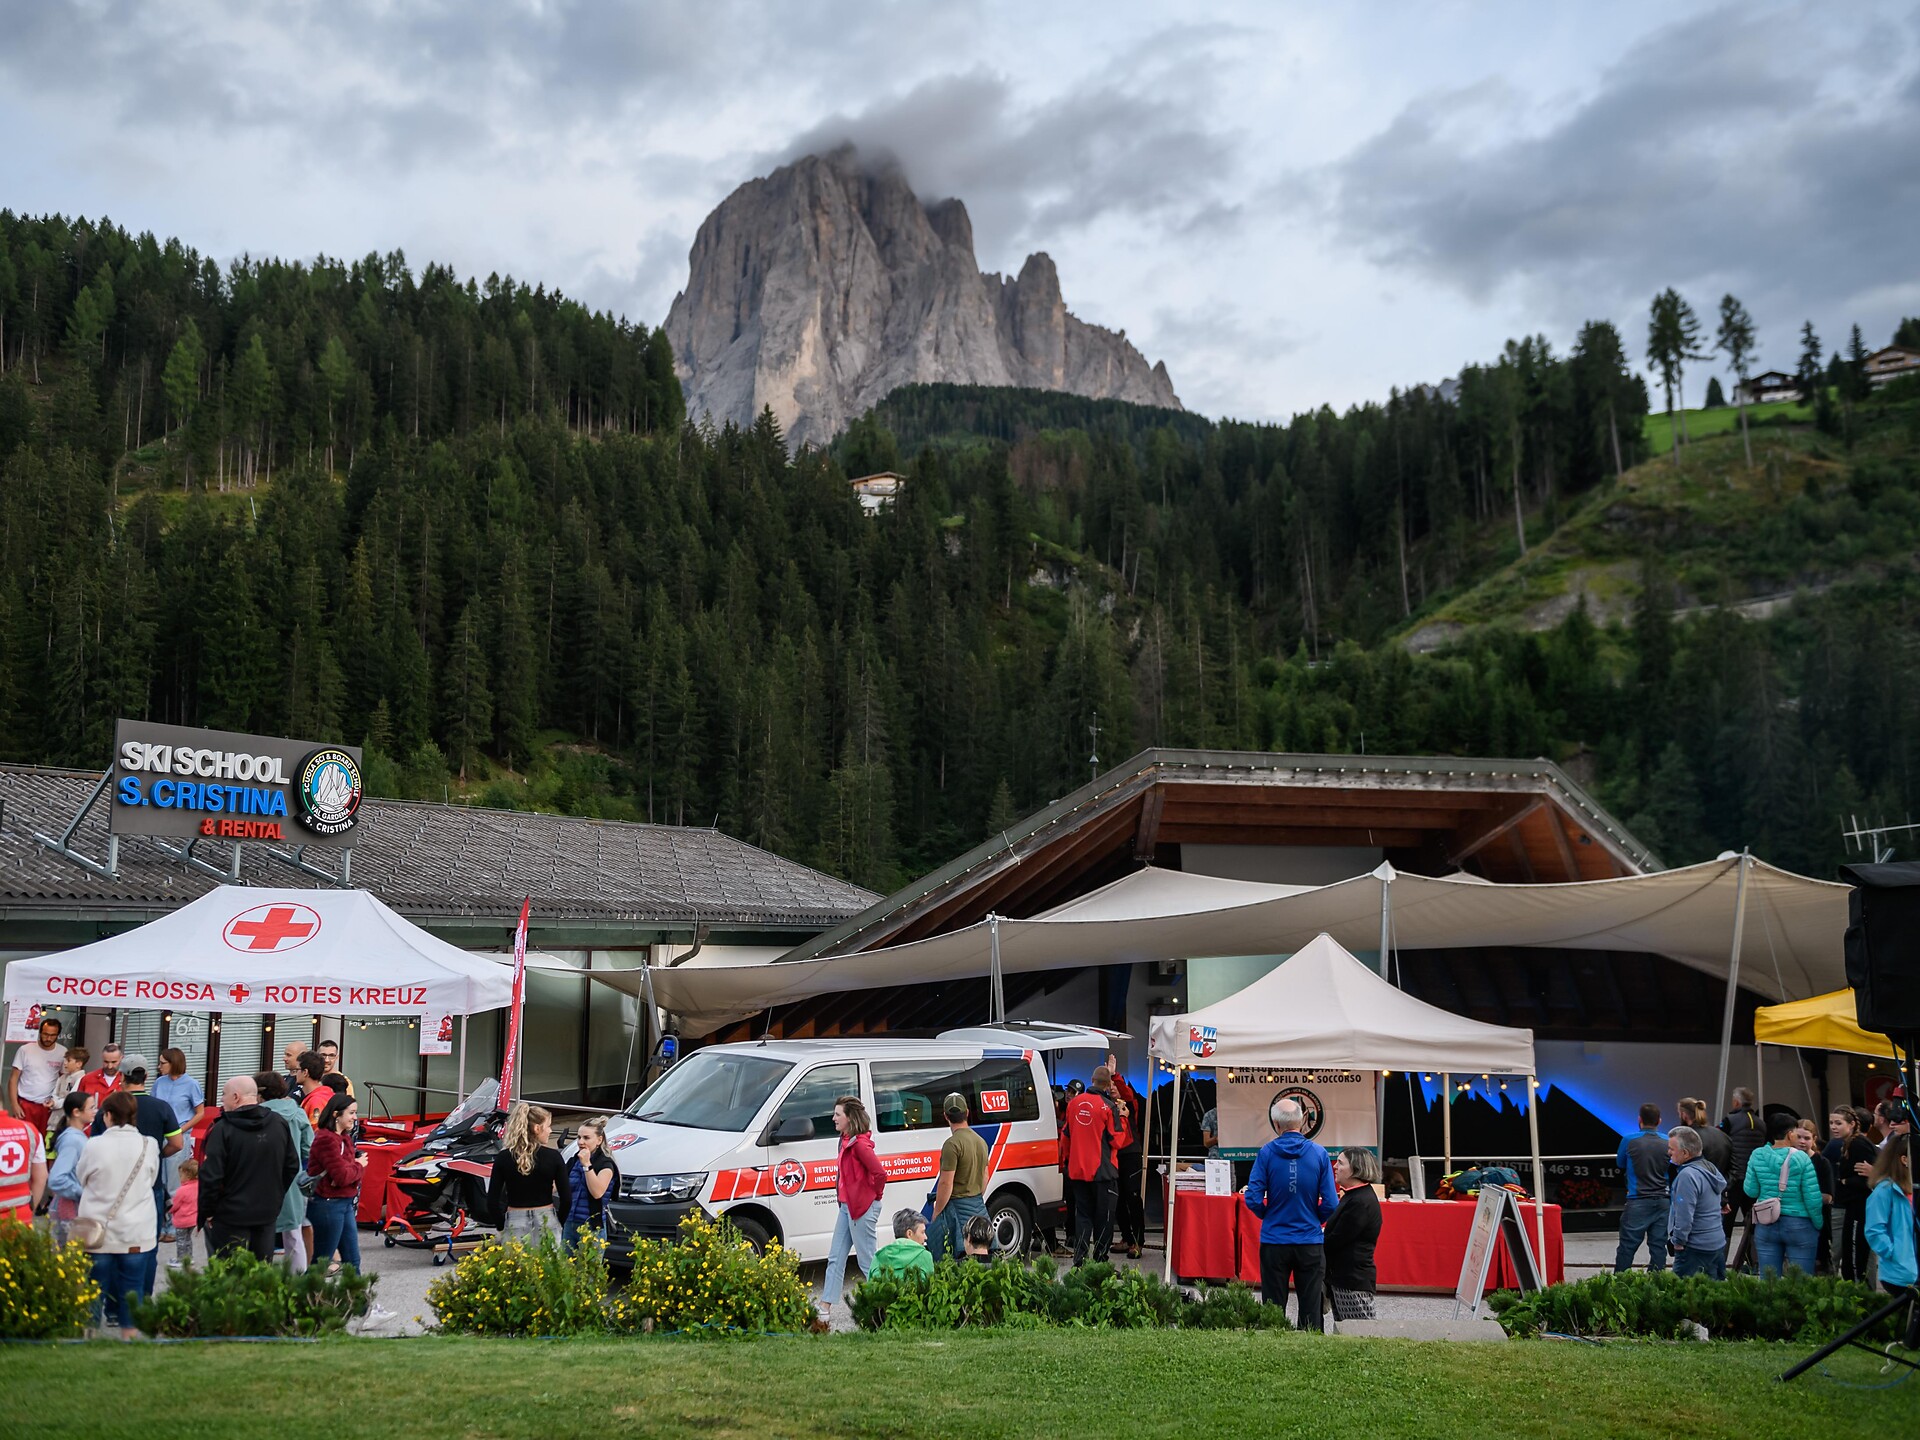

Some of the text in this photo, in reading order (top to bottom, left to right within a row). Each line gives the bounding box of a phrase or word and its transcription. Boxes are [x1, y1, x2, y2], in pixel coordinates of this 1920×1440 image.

[119, 742, 290, 785] SKI SCHOOL
[304, 763, 317, 793] SCUOLA
[315, 755, 326, 765] SCI
[332, 754, 352, 768] BOARD
[119, 776, 288, 816] S. CRISTINA
[311, 804, 351, 820] VAL GARDENA
[201, 818, 286, 840] & RENTAL
[316, 819, 354, 833] CRISTINA
[46, 976, 427, 1005] CROCE ROSSA ROTES KREUZ
[1317, 1074, 1362, 1084] SOCCORSO
[991, 1095, 1007, 1107] 112
[893, 1157, 921, 1167] SÜDTIROL
[892, 1168, 905, 1176] ALTO
[905, 1166, 921, 1174] ADIGE
[1573, 1165, 1589, 1177] 33
